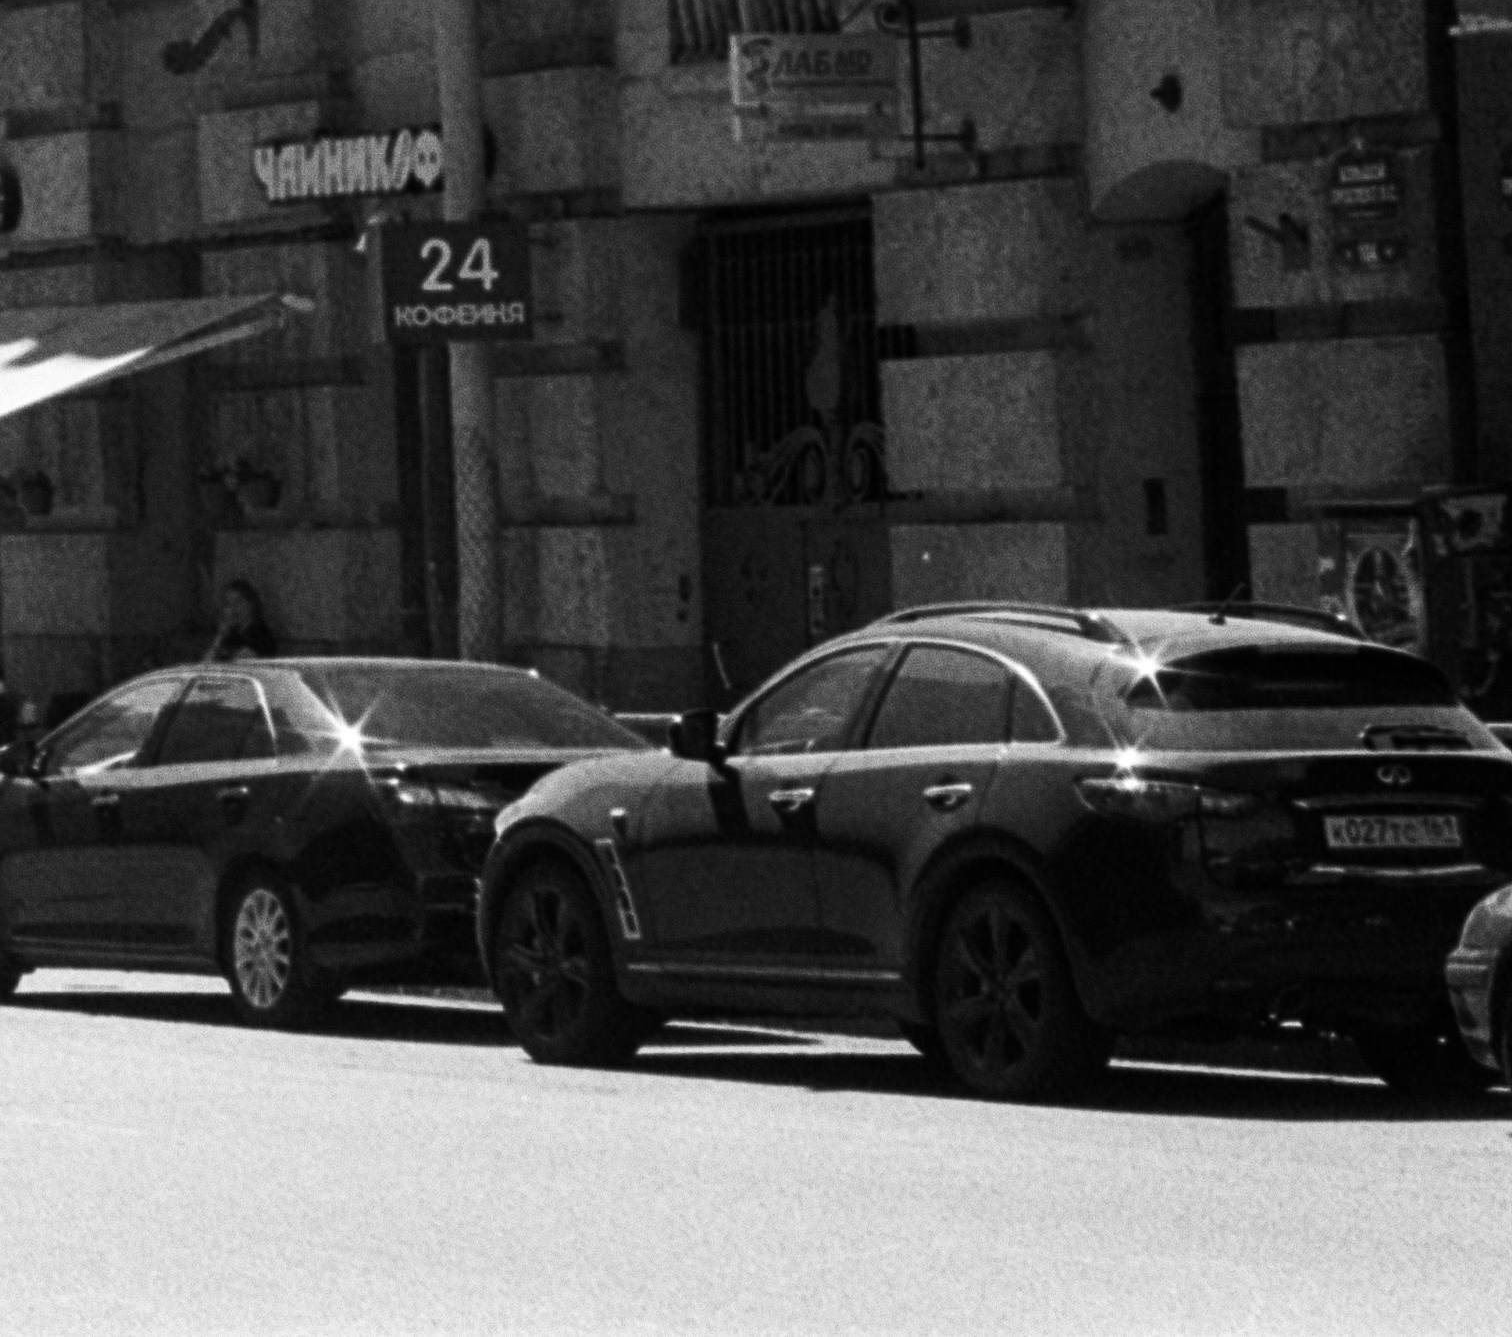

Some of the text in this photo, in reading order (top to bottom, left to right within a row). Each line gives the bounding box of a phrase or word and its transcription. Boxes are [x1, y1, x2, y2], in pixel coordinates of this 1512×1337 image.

[253, 128, 442, 201] ЧАЙНИКОФ
[420, 237, 500, 292] 24
[394, 301, 526, 327] КОФЕЙНЯ
